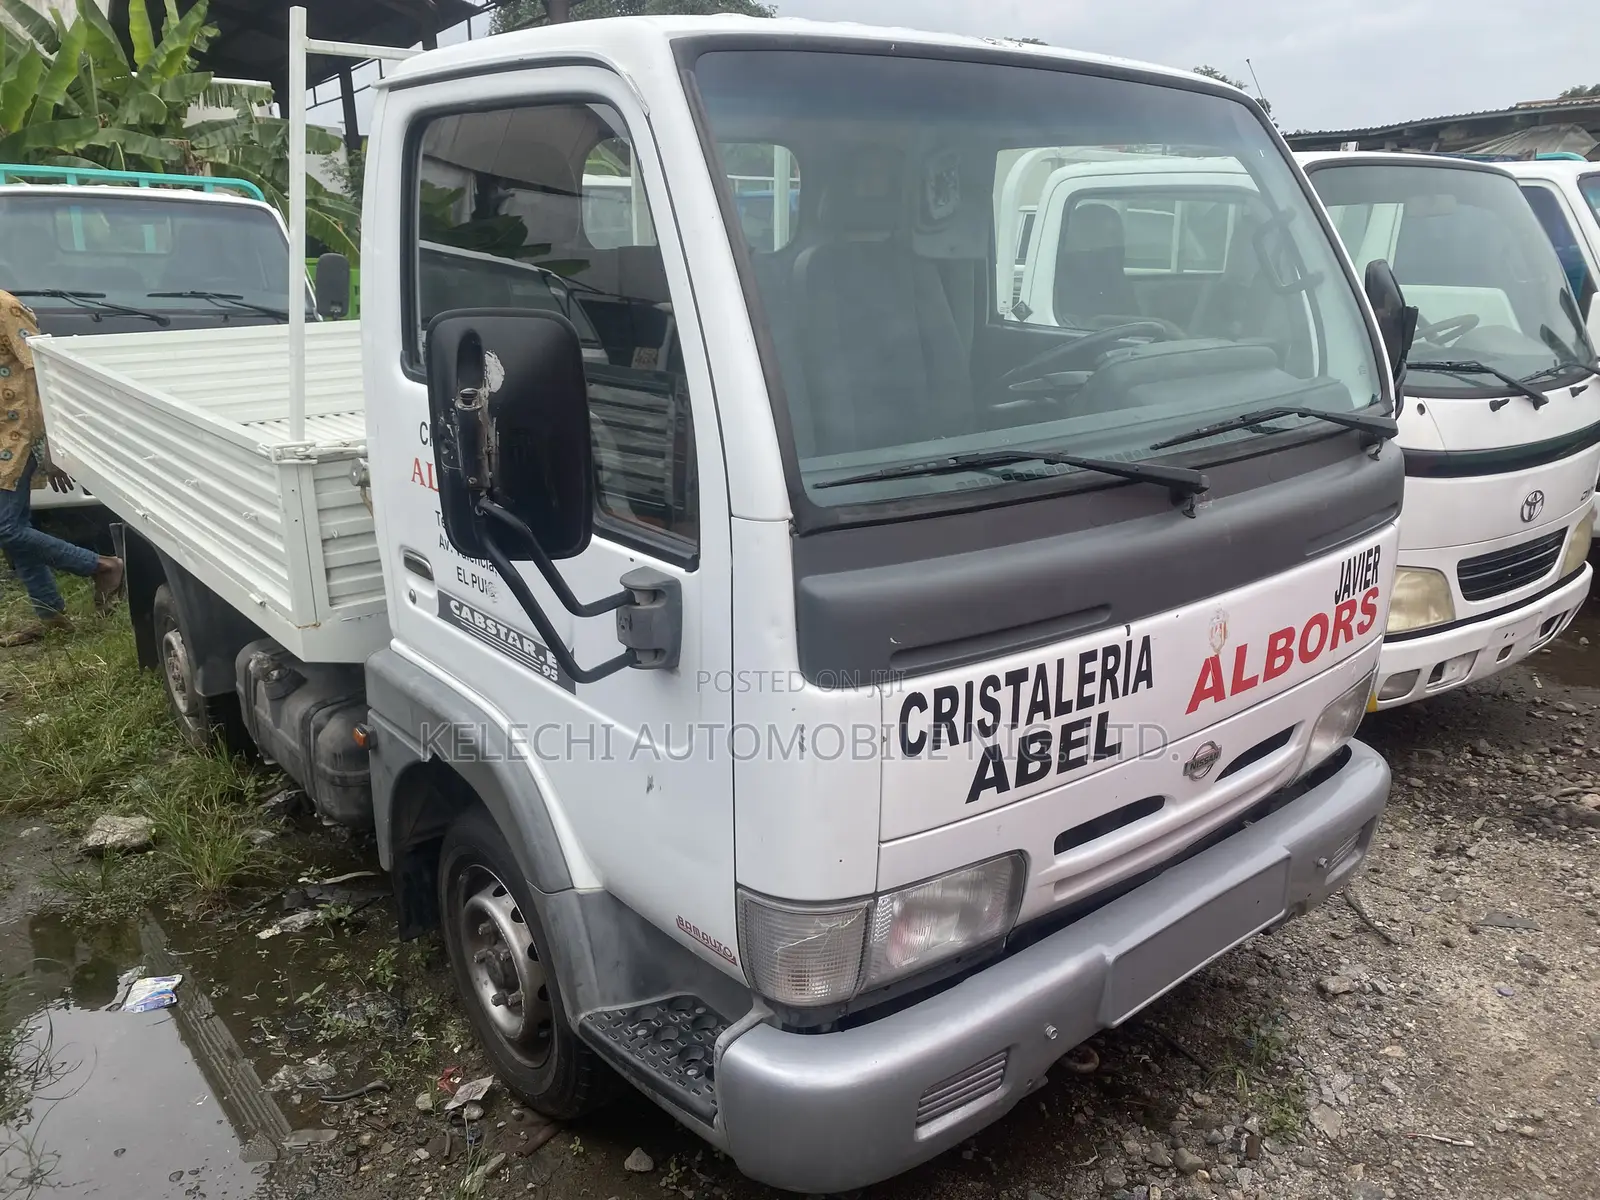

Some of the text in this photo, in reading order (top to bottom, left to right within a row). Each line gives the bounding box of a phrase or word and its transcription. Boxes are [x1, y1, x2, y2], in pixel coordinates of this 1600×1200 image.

[456, 565, 470, 586] EL
[1334, 544, 1381, 605] JAVIER
[1185, 587, 1380, 714] ALBORS
[542, 665, 558, 681] 95
[965, 710, 1123, 804] ABEL
[1190, 750, 1219, 770] NISSAN
